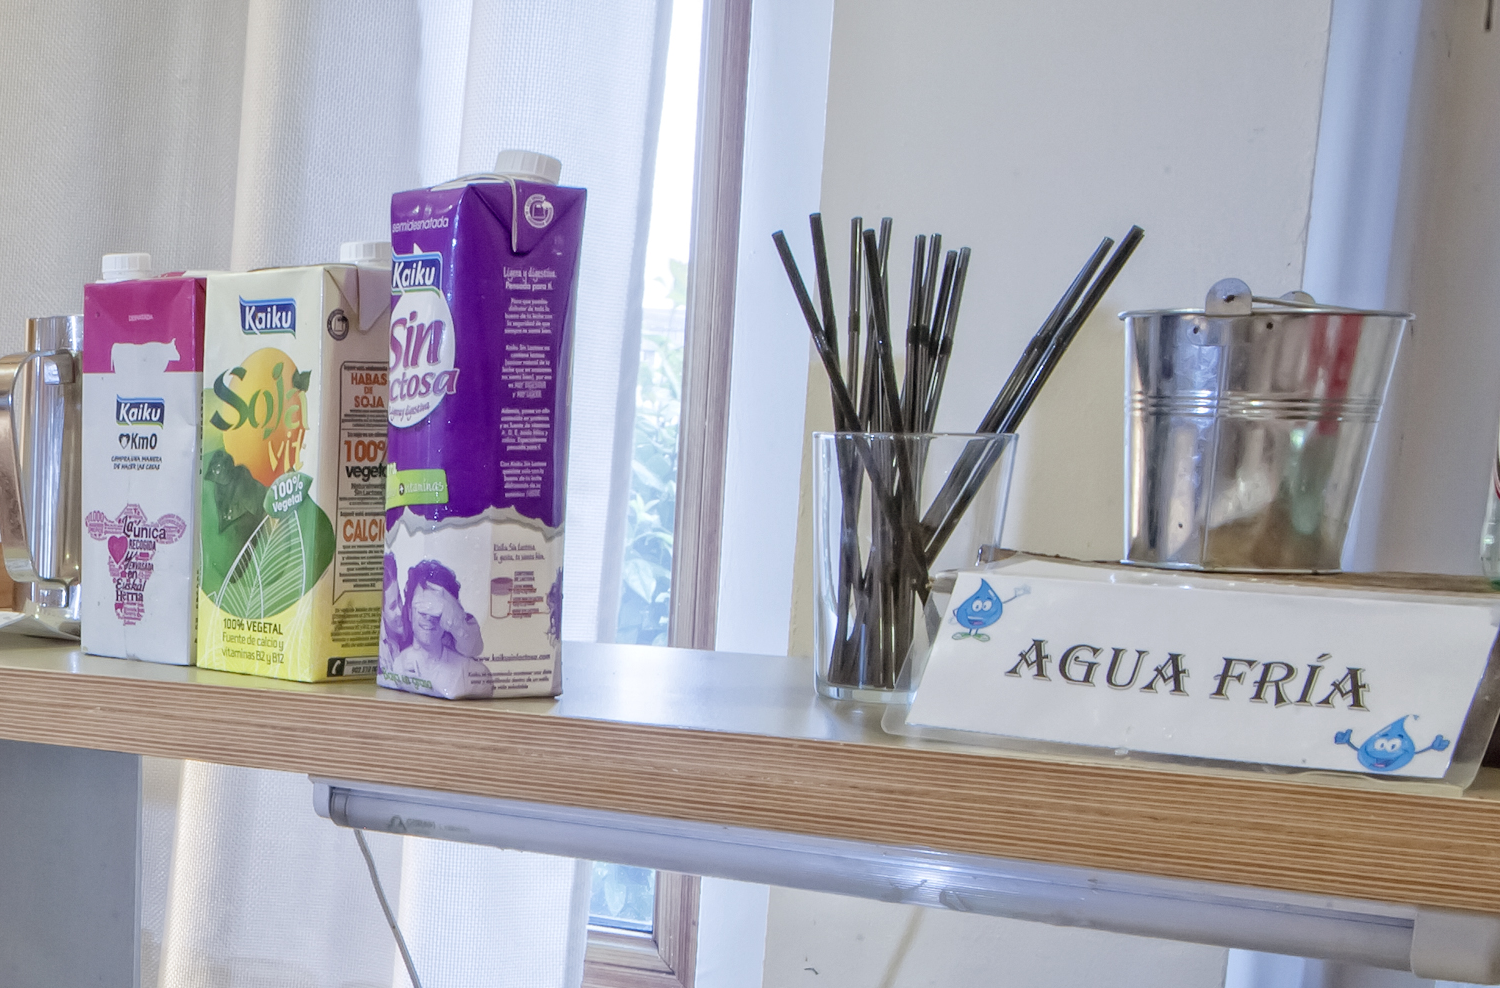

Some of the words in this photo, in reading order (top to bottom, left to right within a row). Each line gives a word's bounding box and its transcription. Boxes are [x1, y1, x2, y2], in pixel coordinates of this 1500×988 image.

[392, 216, 449, 233] semidesnatada
[392, 260, 436, 294] Kaiku
[245, 305, 292, 335] Kaiku
[389, 311, 445, 373] Sin
[351, 372, 388, 386] HABAS
[389, 368, 460, 402] ctosa
[209, 361, 311, 441] Soja
[354, 395, 385, 408] SOJA
[119, 402, 161, 426] Kaiku
[268, 428, 304, 473] vit
[345, 463, 387, 482] veget
[271, 473, 304, 501] 100%
[272, 491, 303, 513] Vegetal
[133, 519, 167, 540] única
[343, 518, 386, 543] CALCI
[223, 618, 245, 631] 100%
[246, 620, 284, 636] VEGETAL
[222, 631, 246, 645] Fuente
[246, 635, 256, 646] de
[256, 636, 278, 648] calcio
[278, 640, 285, 652] y
[221, 646, 256, 661] vitaminas
[256, 650, 266, 662] B2
[266, 654, 272, 665] y
[272, 652, 285, 664] B12
[1004, 638, 1190, 697] AGUA
[1209, 653, 1372, 712] FRÍA
